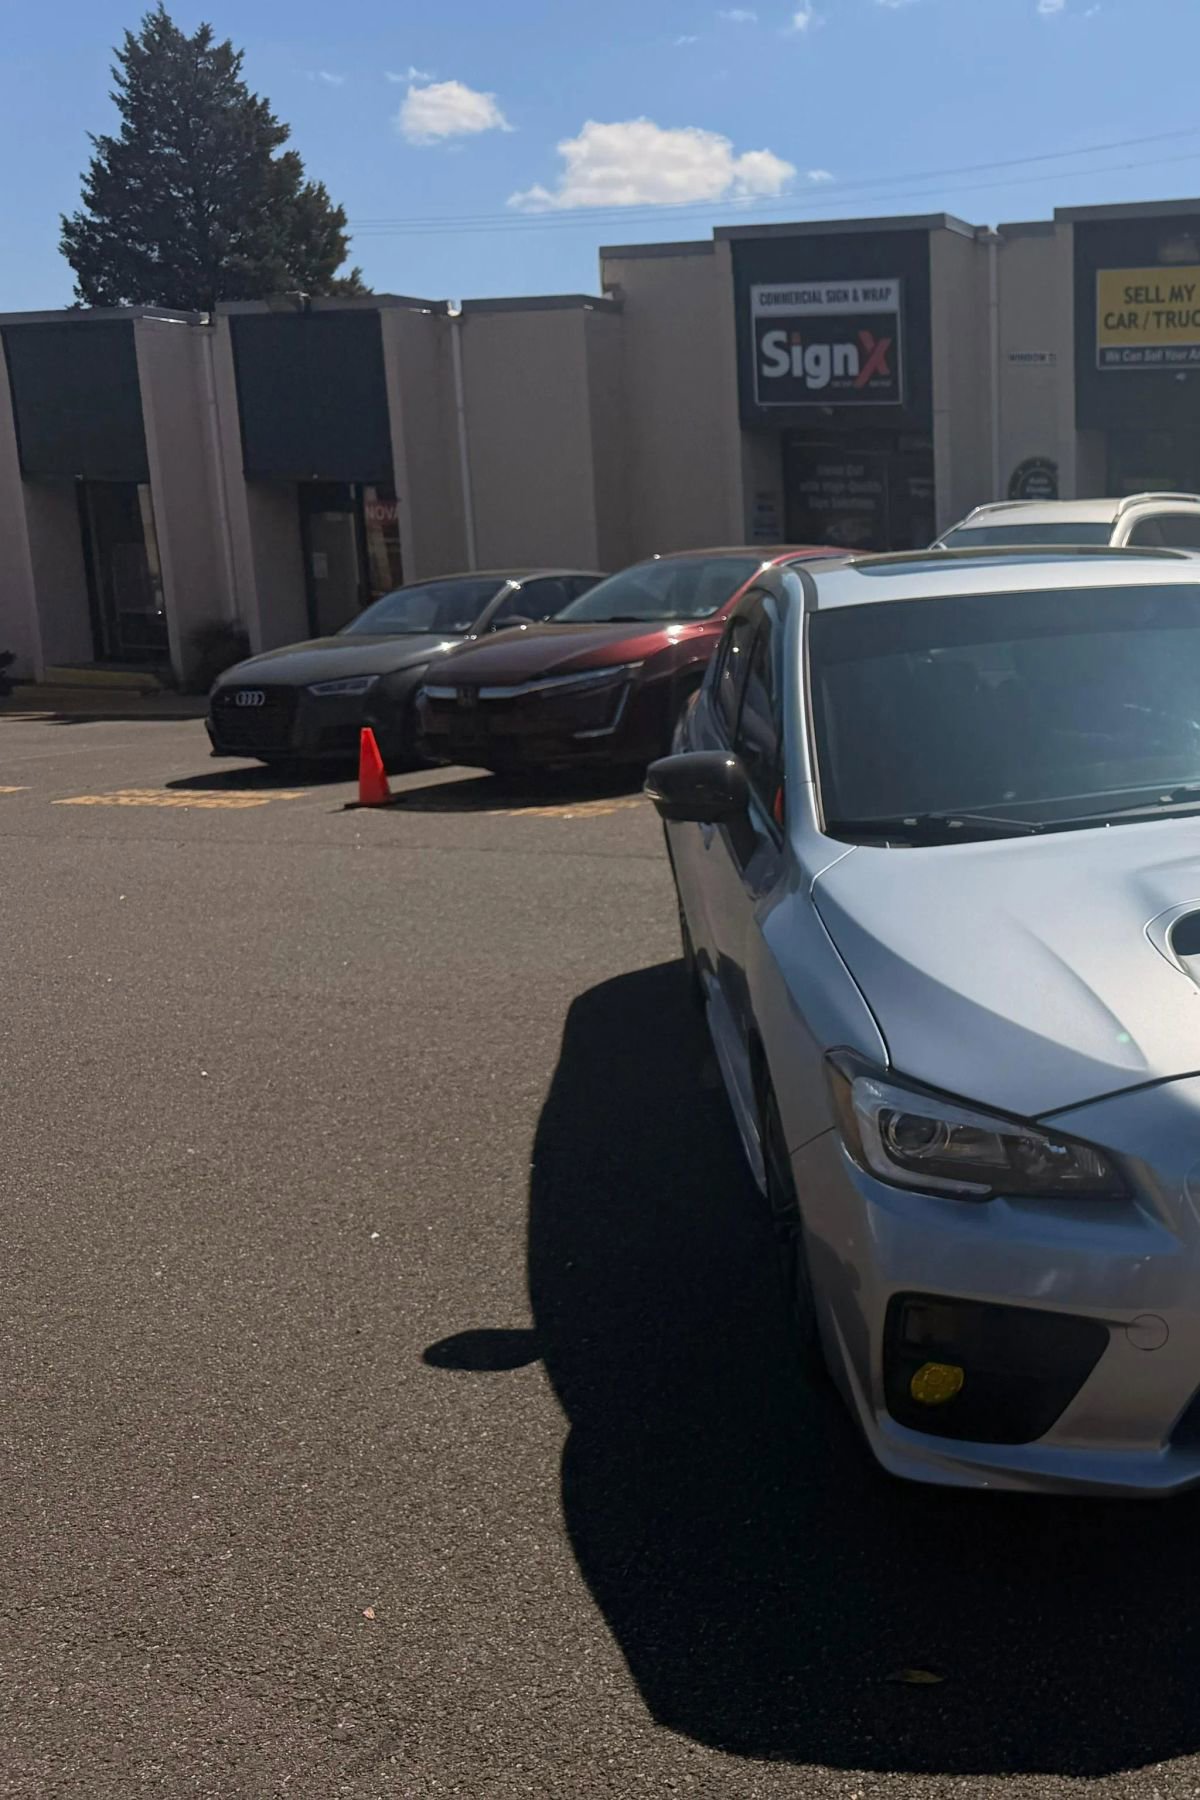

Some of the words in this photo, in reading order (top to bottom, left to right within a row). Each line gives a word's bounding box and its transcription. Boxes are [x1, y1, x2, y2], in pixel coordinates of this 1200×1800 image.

[759, 289, 824, 307] COMMERCIAL
[825, 288, 850, 305] SIGN
[852, 287, 859, 303] &
[861, 286, 892, 302] WRAP
[1124, 286, 1165, 305] SELL
[1169, 283, 1197, 303] MY
[1104, 311, 1139, 331] CAR
[761, 329, 892, 390] SignX
[1122, 349, 1142, 362] Can
